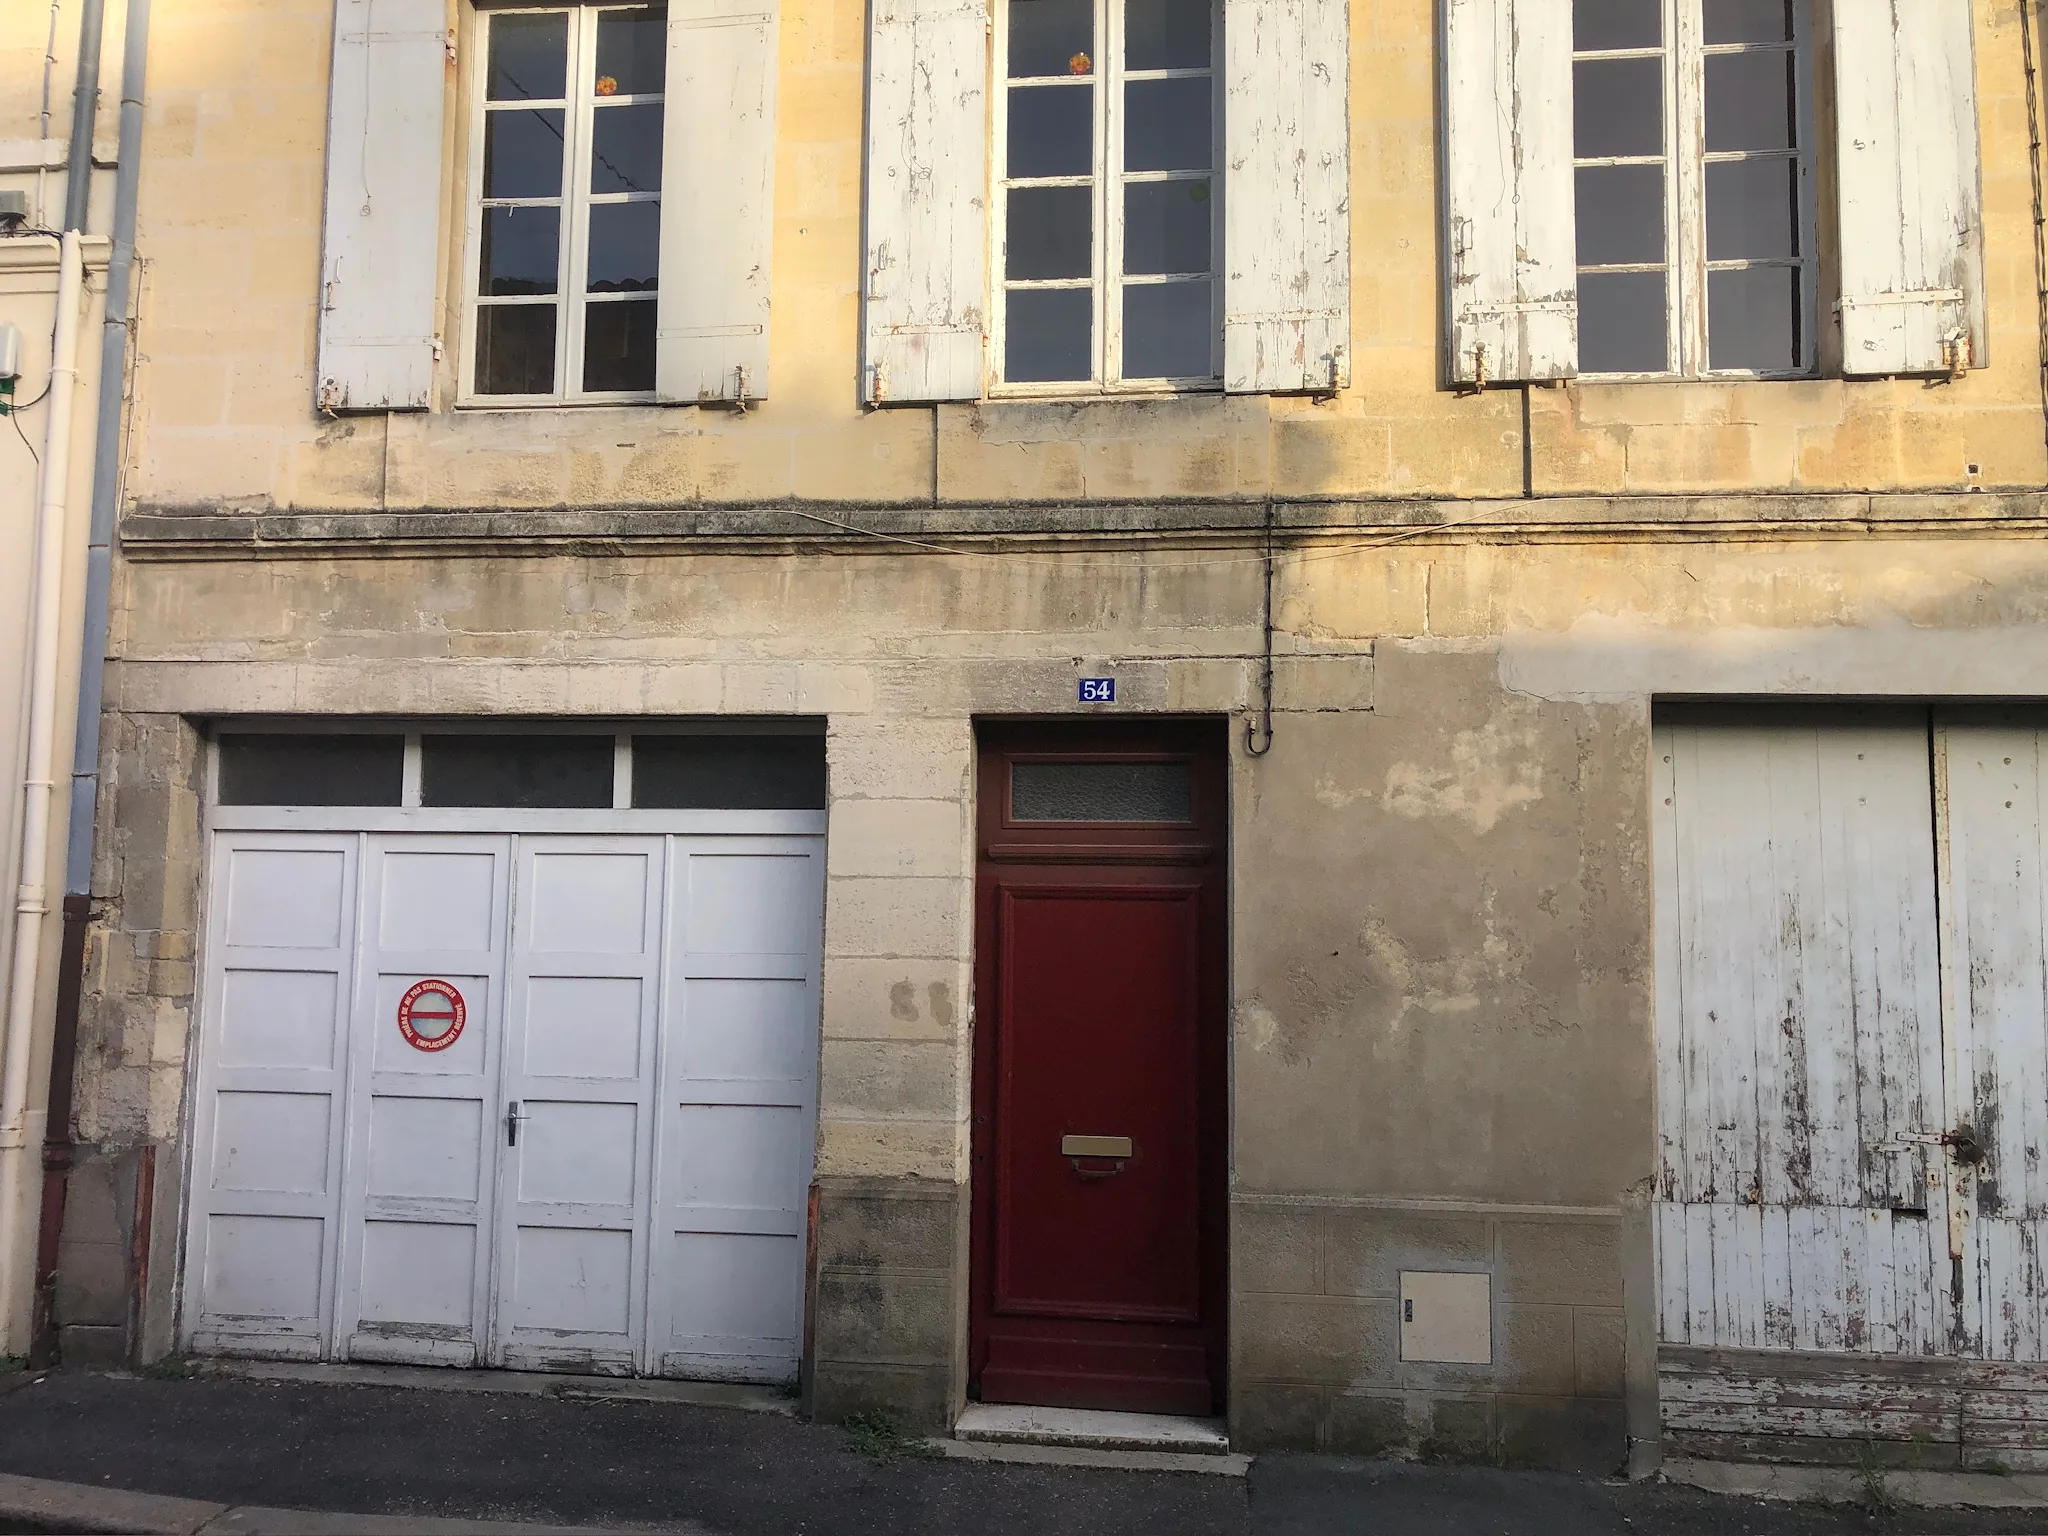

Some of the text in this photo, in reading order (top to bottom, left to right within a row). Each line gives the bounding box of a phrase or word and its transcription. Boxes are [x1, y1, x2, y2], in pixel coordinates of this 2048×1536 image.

[1084, 681, 1111, 700] 54
[401, 982, 456, 1038] PRIÈRE DE NE PAS STATIONNER
[416, 1002, 464, 1048] EMPLACEMENT RÉSERVÉ
